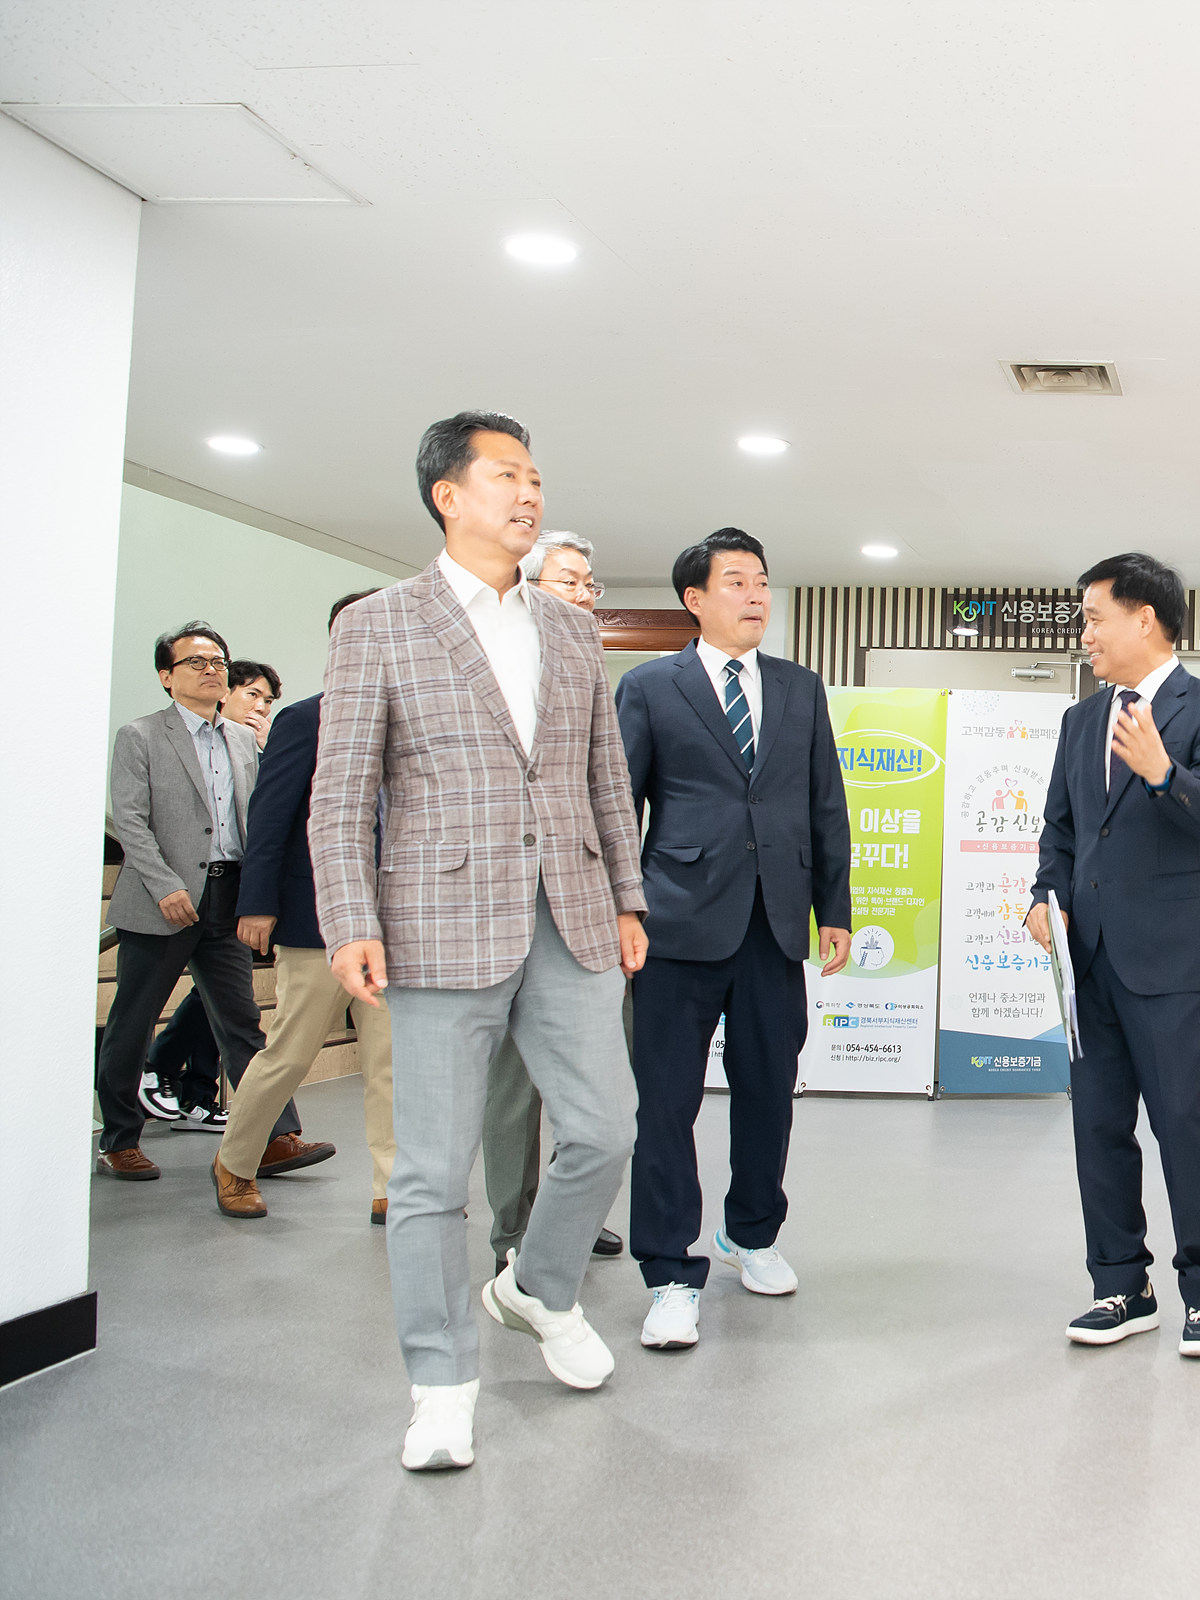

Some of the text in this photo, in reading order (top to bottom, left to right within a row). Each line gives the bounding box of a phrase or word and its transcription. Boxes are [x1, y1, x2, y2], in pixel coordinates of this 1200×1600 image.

[953, 600, 997, 622] KODIT
[961, 726, 1006, 738] 고객감동
[836, 747, 923, 773] 지식재산!
[860, 808, 921, 834] 이상을
[976, 810, 1009, 833] 공감
[982, 842, 1037, 852] 신용보증기금
[965, 876, 1028, 895] 고객과 공감
[996, 903, 1027, 920] 감동
[996, 929, 1026, 945] 신뢰
[968, 992, 1046, 1003] 언제나 중소기업과
[971, 1007, 1044, 1018] 함께 하겠습니다!
[824, 1017, 858, 1028] RIPC
[846, 1043, 902, 1053] 054-454-6613
[845, 1055, 902, 1063] http://biz.ripc.org/
[993, 1055, 1042, 1068] 신용보증기금
